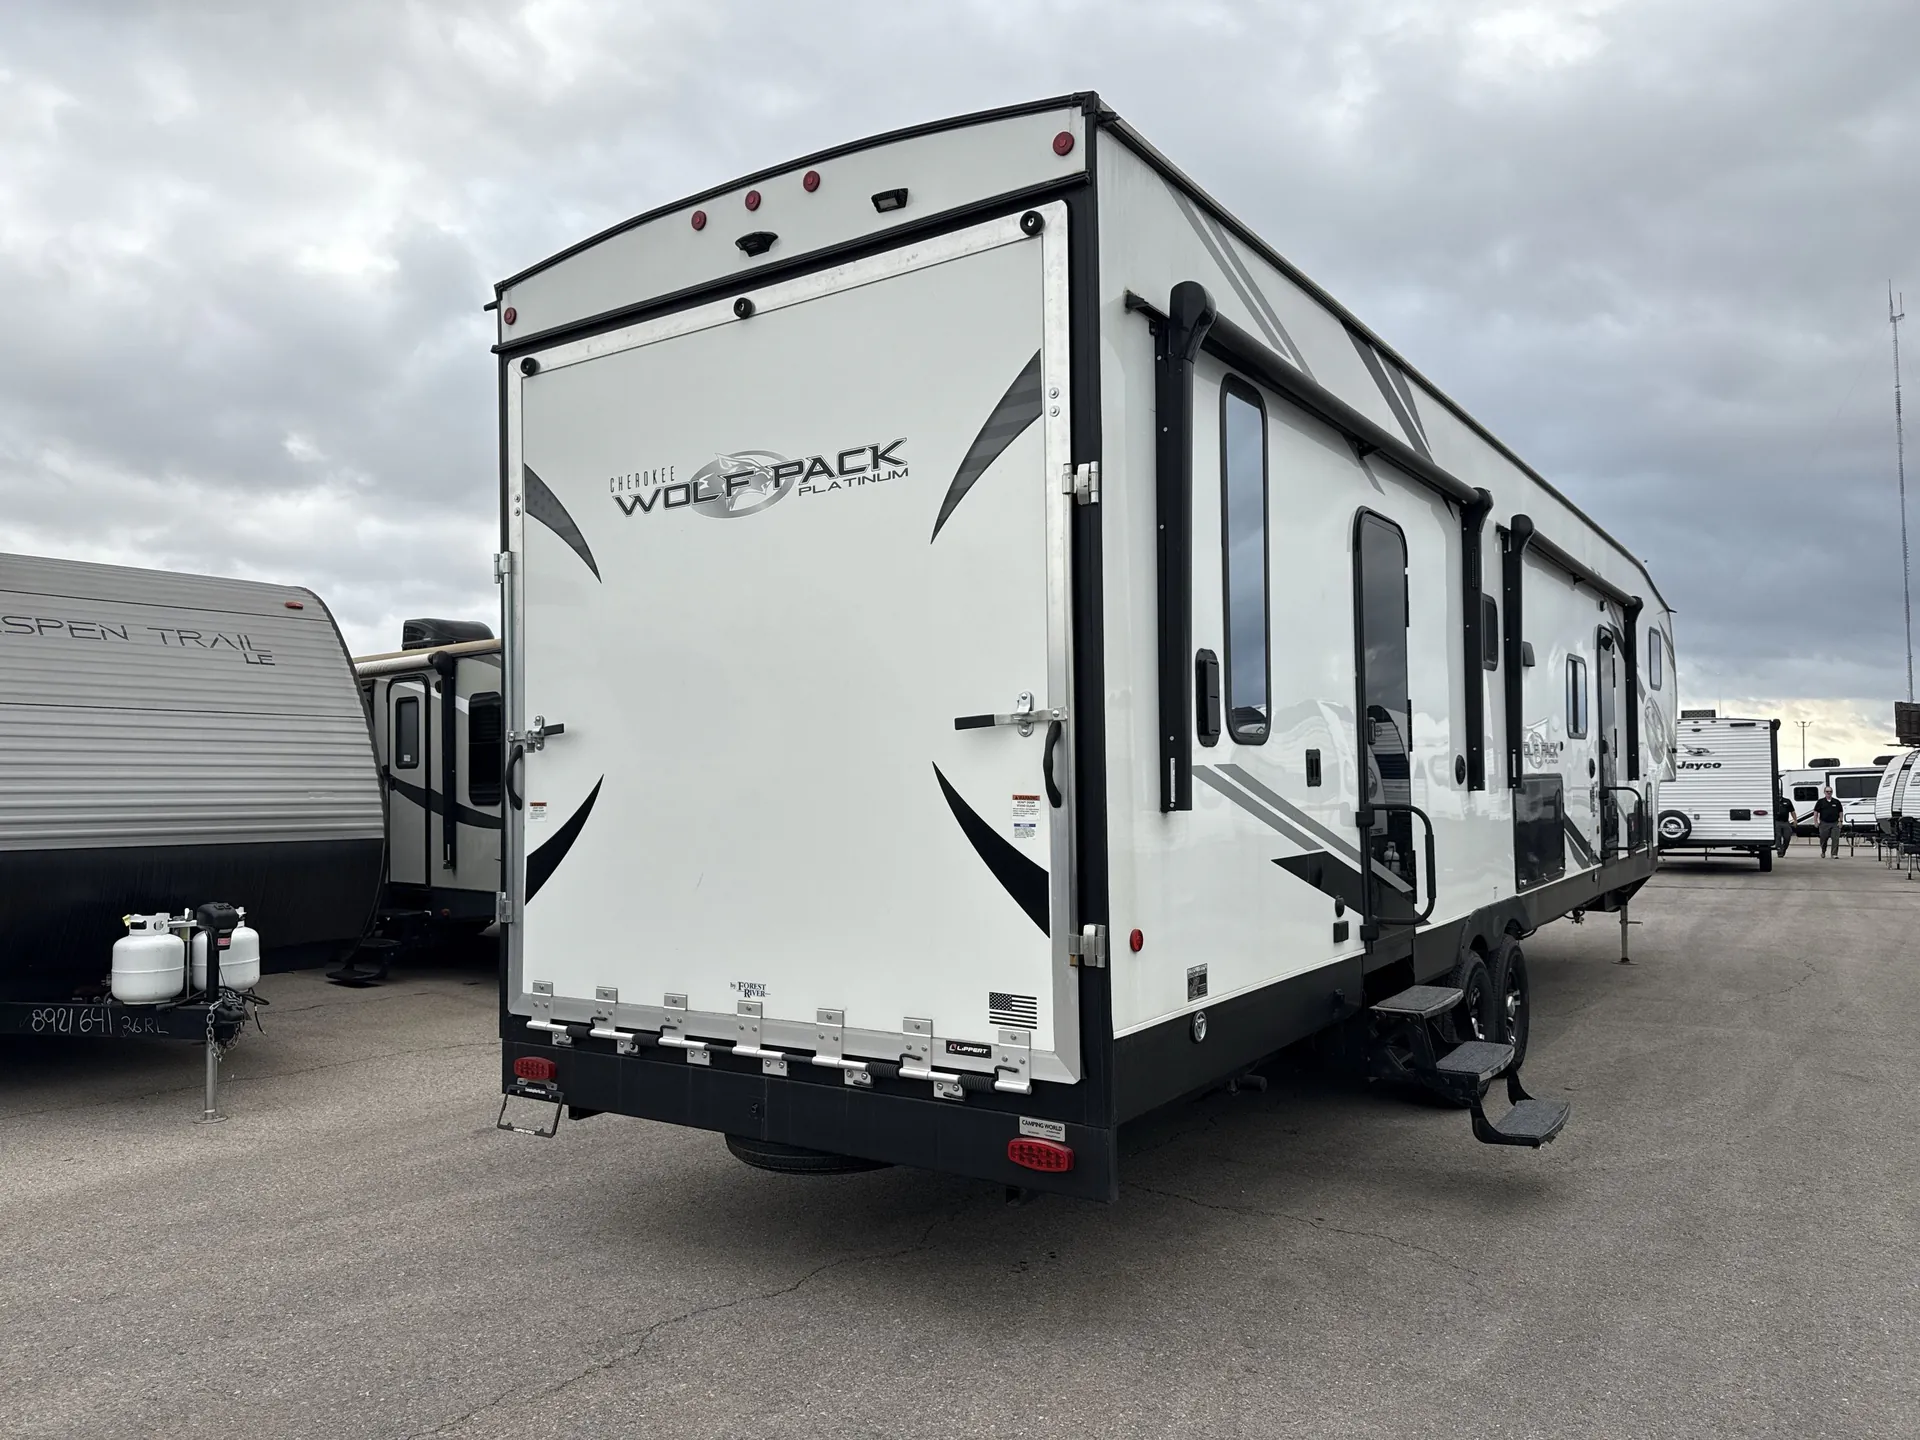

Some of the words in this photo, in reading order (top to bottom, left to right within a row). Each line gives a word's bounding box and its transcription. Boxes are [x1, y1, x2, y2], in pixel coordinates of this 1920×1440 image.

[609, 465, 676, 493] CHEROKEE
[612, 469, 756, 518] WOLF
[765, 437, 909, 491] PACK
[798, 468, 909, 497] PLATINUM
[0, 615, 130, 641] SPEN
[146, 627, 272, 653] TRAIL
[243, 652, 276, 667] LE
[1677, 760, 1722, 770] Jayco
[738, 982, 766, 991] FOREST
[744, 989, 766, 998] RIVER
[1021, 1119, 1044, 1129] CAMPING
[1044, 1123, 1063, 1132] WORLD
